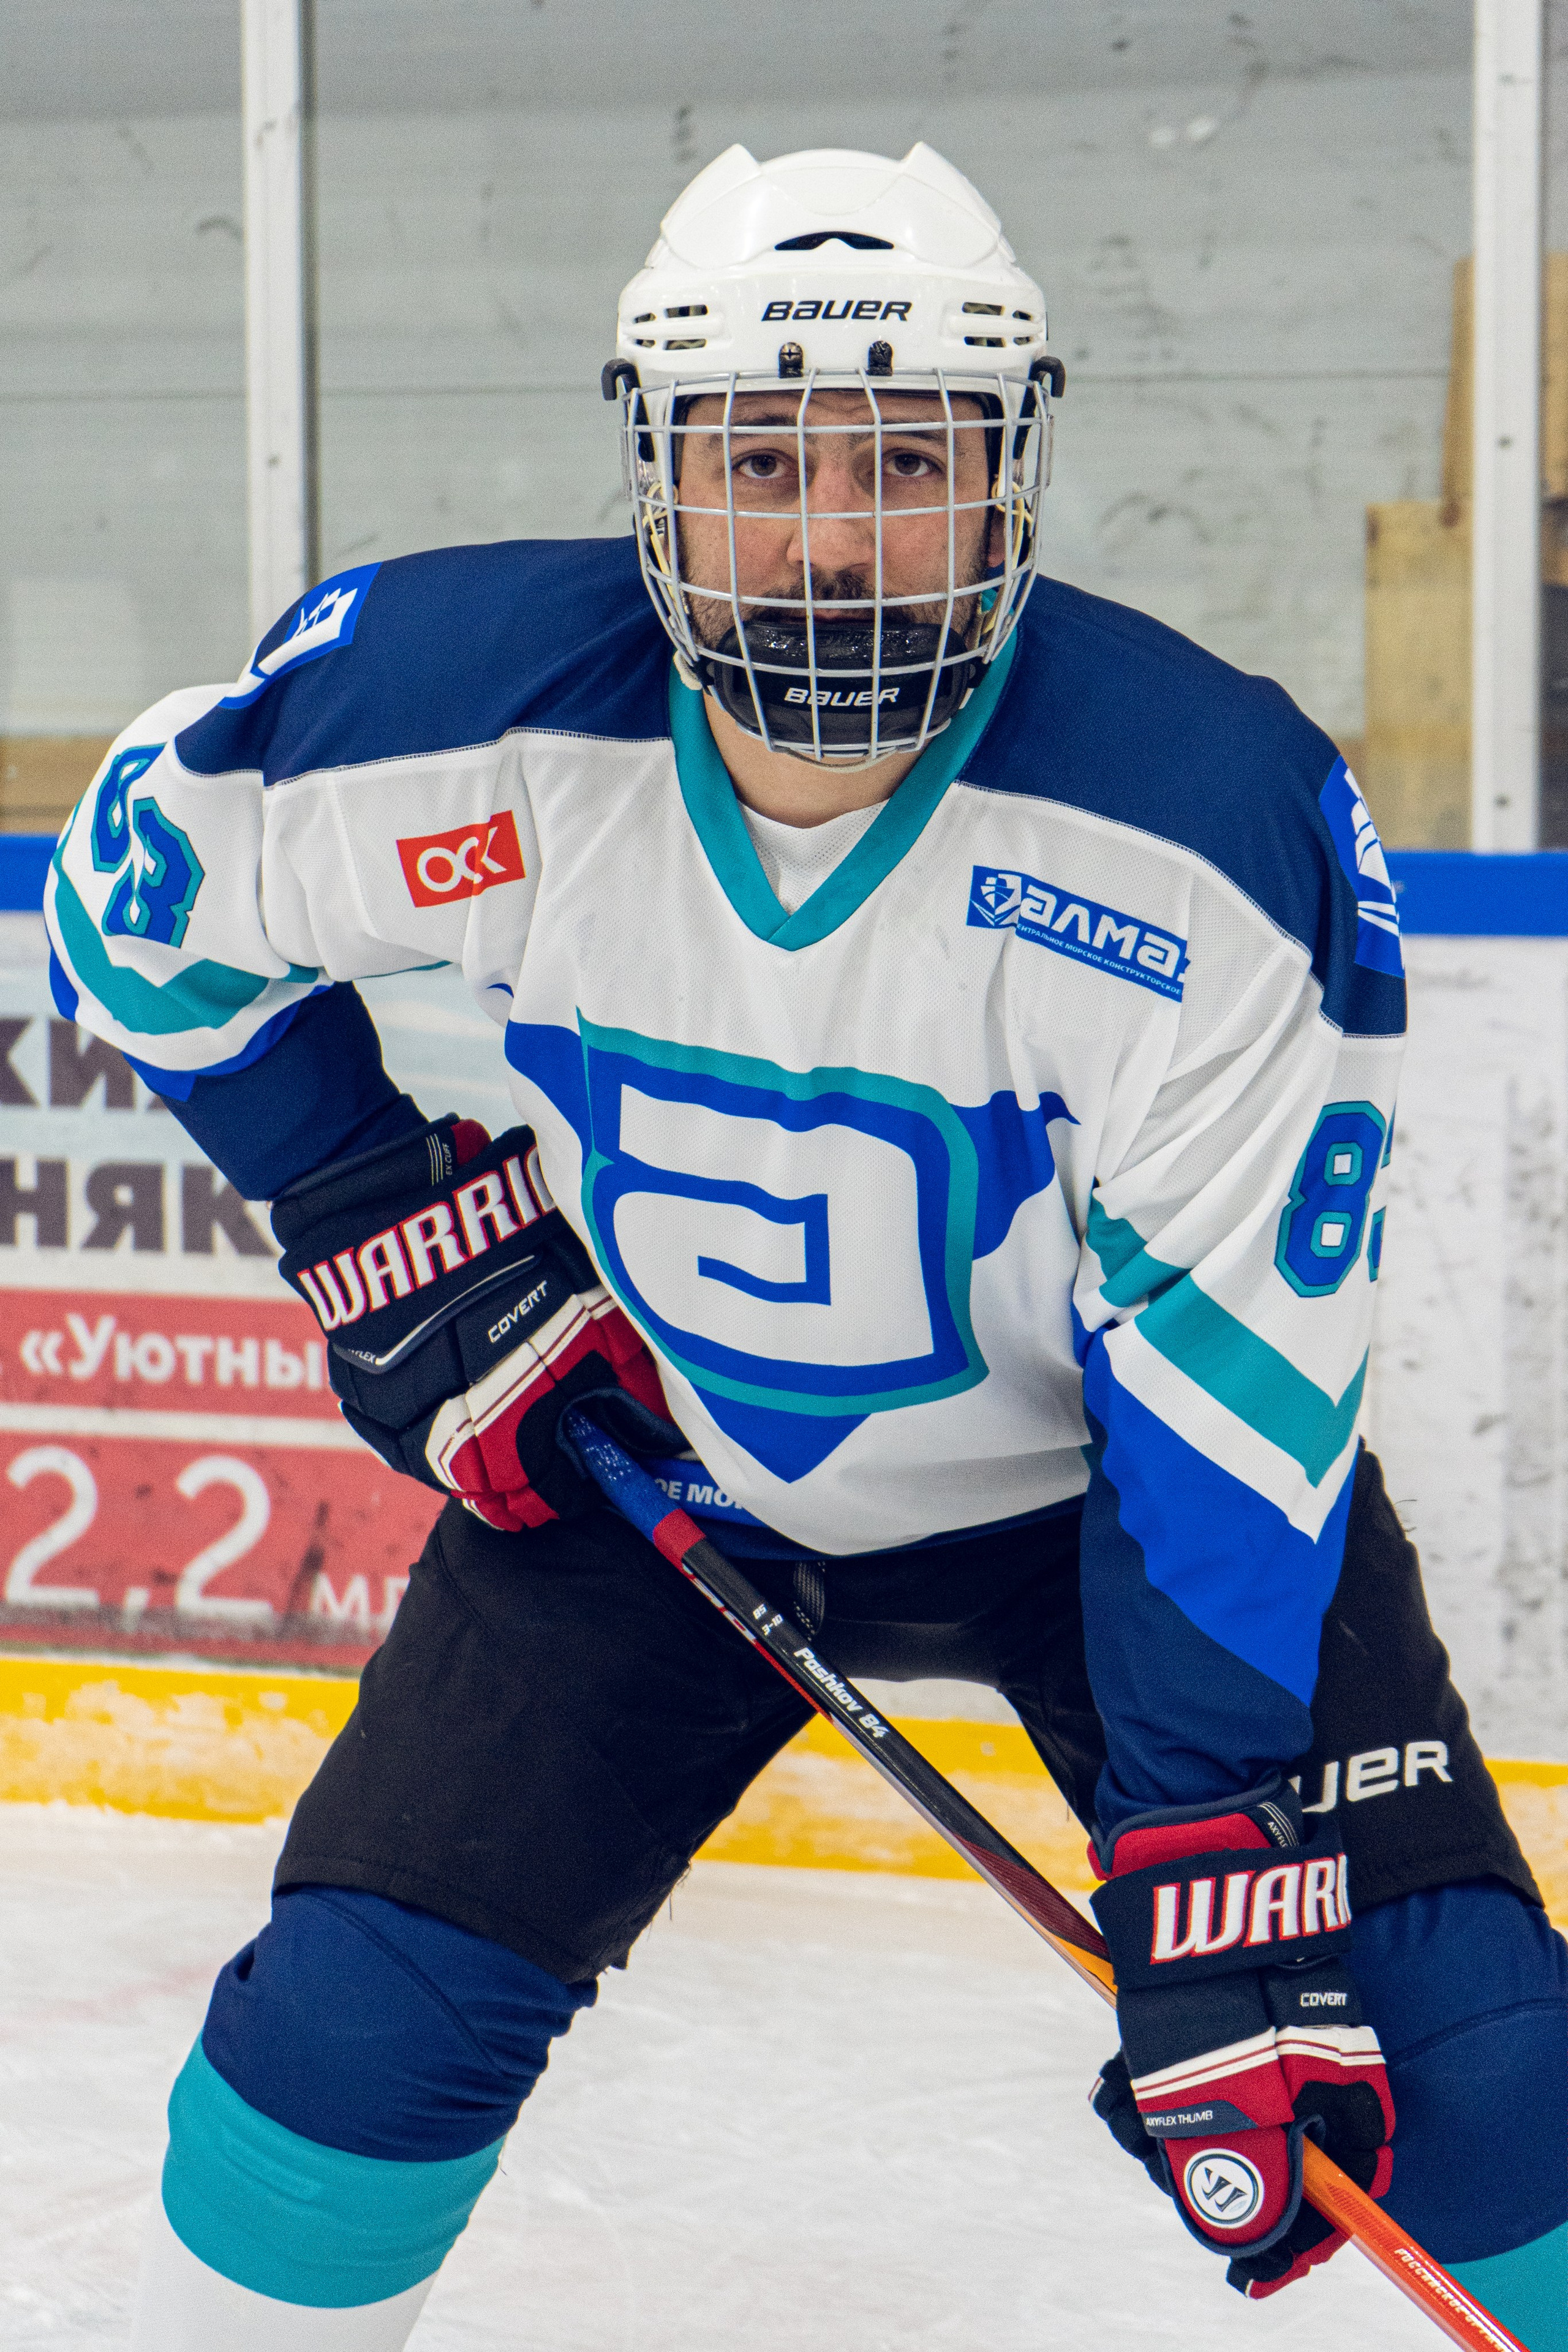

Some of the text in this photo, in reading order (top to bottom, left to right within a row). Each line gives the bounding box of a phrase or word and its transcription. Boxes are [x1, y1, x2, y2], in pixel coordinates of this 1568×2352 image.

[1017, 922, 1181, 995] ЕНТРАЛЬНОЕ МОРСКОЕ КОНСТРУКТОРСКОЕ
[488, 1280, 548, 1343] COVERT
[686, 1483, 742, 1510] МО
[7, 1444, 276, 1634] 2,2
[793, 1647, 890, 1738] Pashkov 84
[1300, 1992, 1347, 2008] COVERT
[1145, 2110, 1213, 2127] AXYFLEX THUMB
